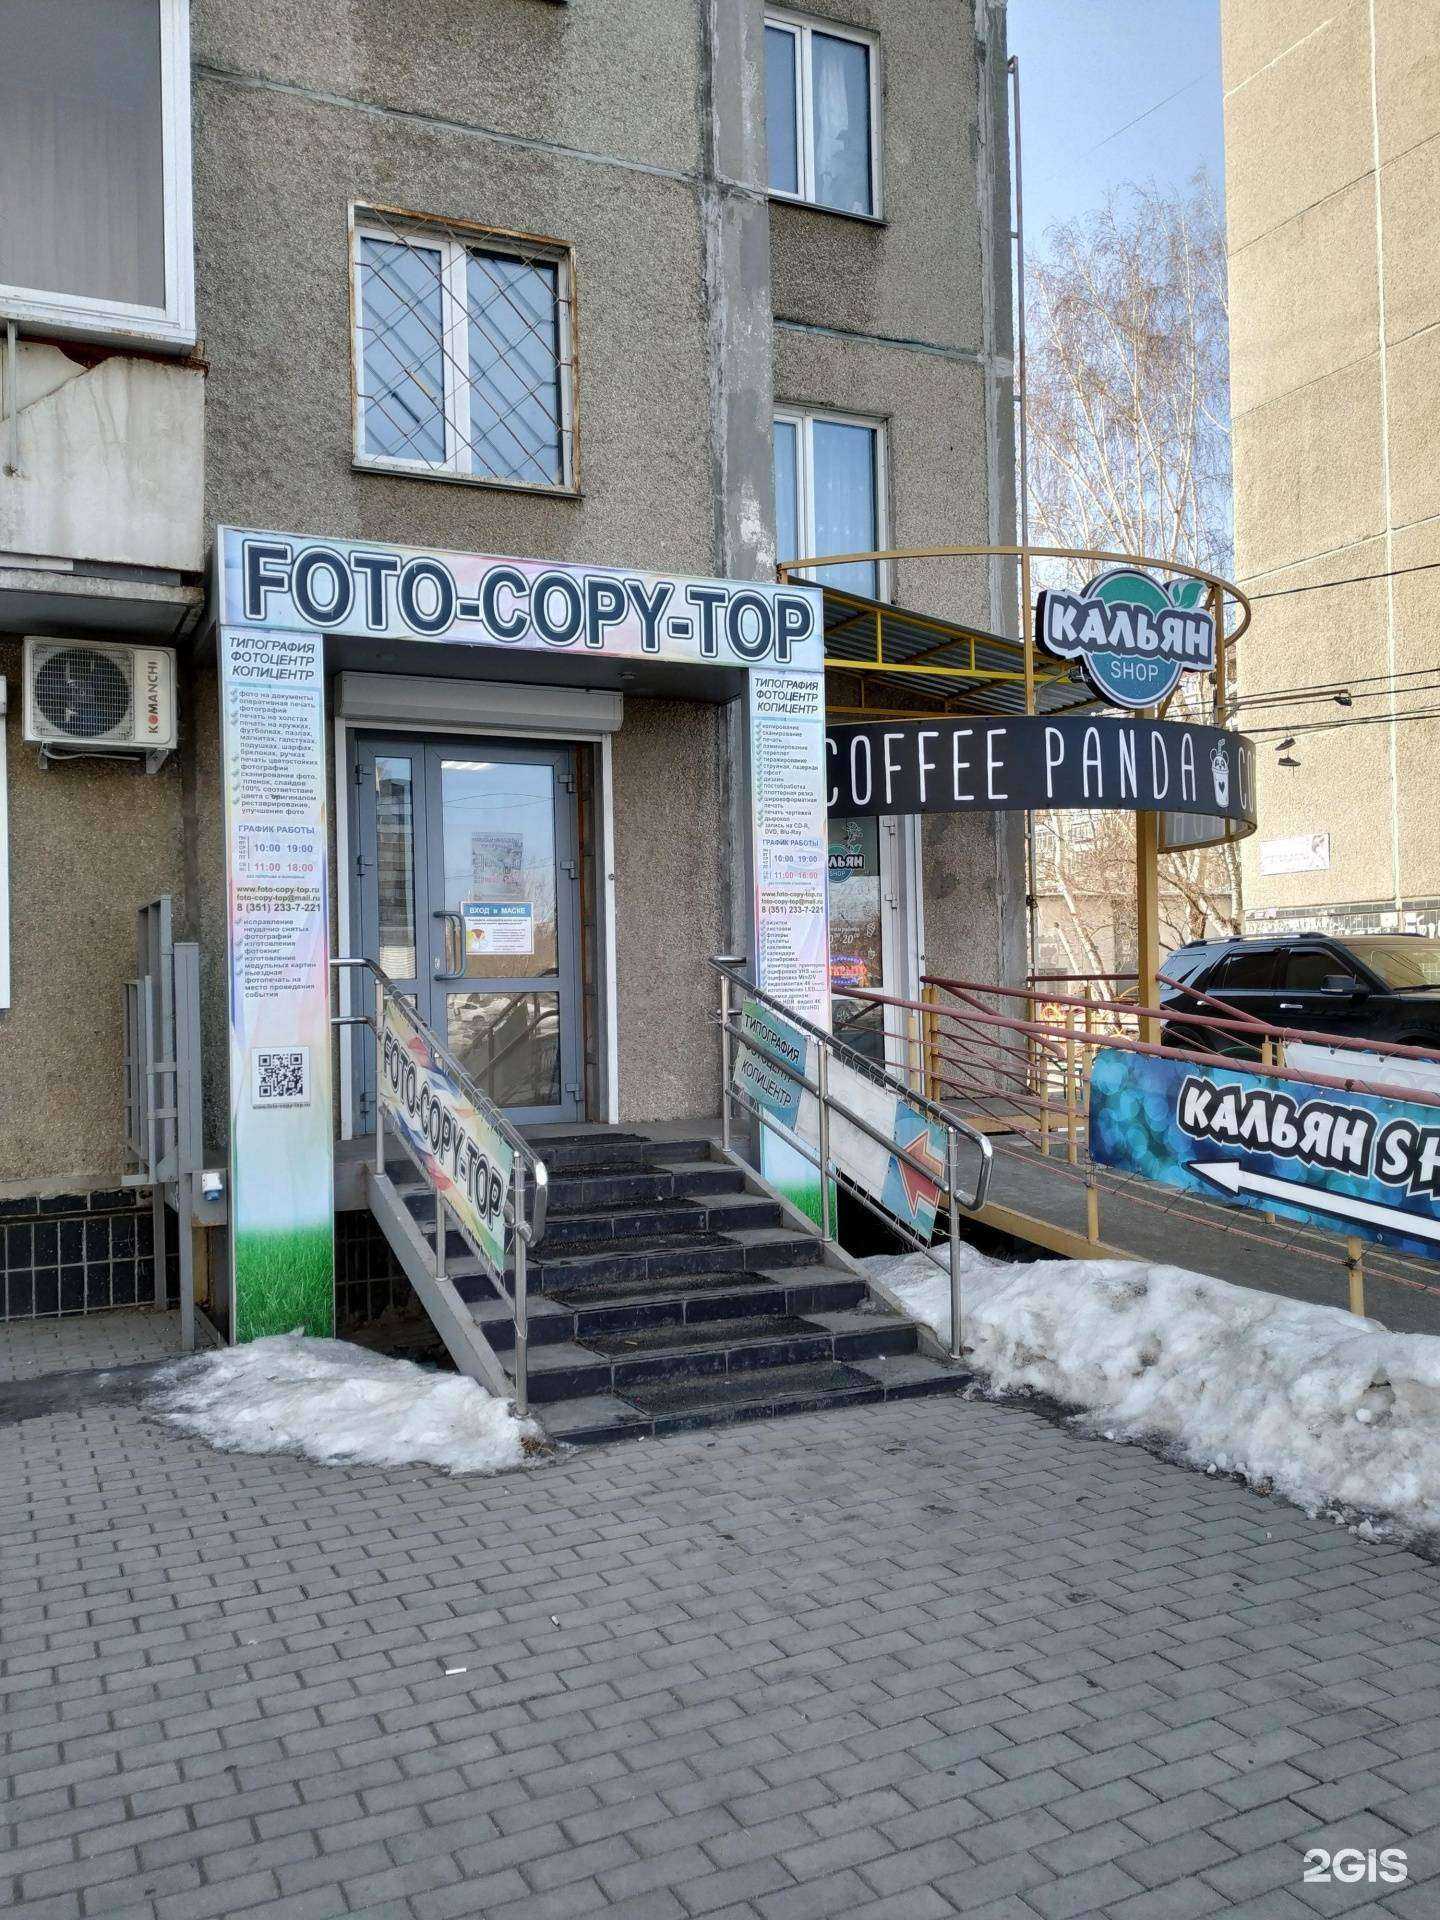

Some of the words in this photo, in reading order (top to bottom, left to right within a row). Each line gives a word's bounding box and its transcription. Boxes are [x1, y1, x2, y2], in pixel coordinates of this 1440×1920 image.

[243, 540, 814, 663] FOTO-COPY-TOP
[1051, 602, 1210, 658] КАЛЬЯН
[229, 637, 315, 653] ТИПОГРАФИЯ
[230, 651, 315, 667] ФОТОЦЕНТР
[232, 665, 315, 681] КОПИЦЕНТР
[1110, 660, 1159, 682] SHOP
[754, 677, 819, 691] ТИПОГРАФИЯ
[147, 661, 159, 734] KOMANCHI
[239, 690, 259, 699] фото
[272, 693, 314, 701] документы
[756, 690, 819, 702] ФОТОЦЕНТР
[240, 699, 288, 707] оперативная
[757, 702, 818, 714] КОПИЦЕНТР
[1045, 727, 1197, 801] PANDA
[240, 771, 295, 779] сканирование
[285, 808, 305, 816] фото
[238, 825, 275, 833] ГРАФИК
[276, 826, 315, 834] РАБОТЫ
[255, 843, 281, 852] 10:00
[762, 839, 790, 847] ГРАФИК
[790, 839, 819, 847] РАБОТЫ
[255, 863, 281, 872] 11:00
[236, 886, 320, 895] www.foto-copy-top.ru
[236, 903, 243, 912] 8
[246, 903, 271, 913] (351)
[274, 903, 320, 912] 233-7-221
[469, 907, 490, 915] ВХОД
[501, 907, 526, 915] МАСКЕ
[761, 906, 767, 914] 8
[768, 906, 787, 915] (351)
[788, 906, 824, 914] 233-7-221
[744, 1013, 800, 1065] ТИПОГРАФИЯ
[741, 1058, 792, 1106] КОПИЦЕНТР
[383, 1030, 504, 1232] FOTO-COPY-TOP
[1182, 1085, 1369, 1168] КАЛЬЯН
